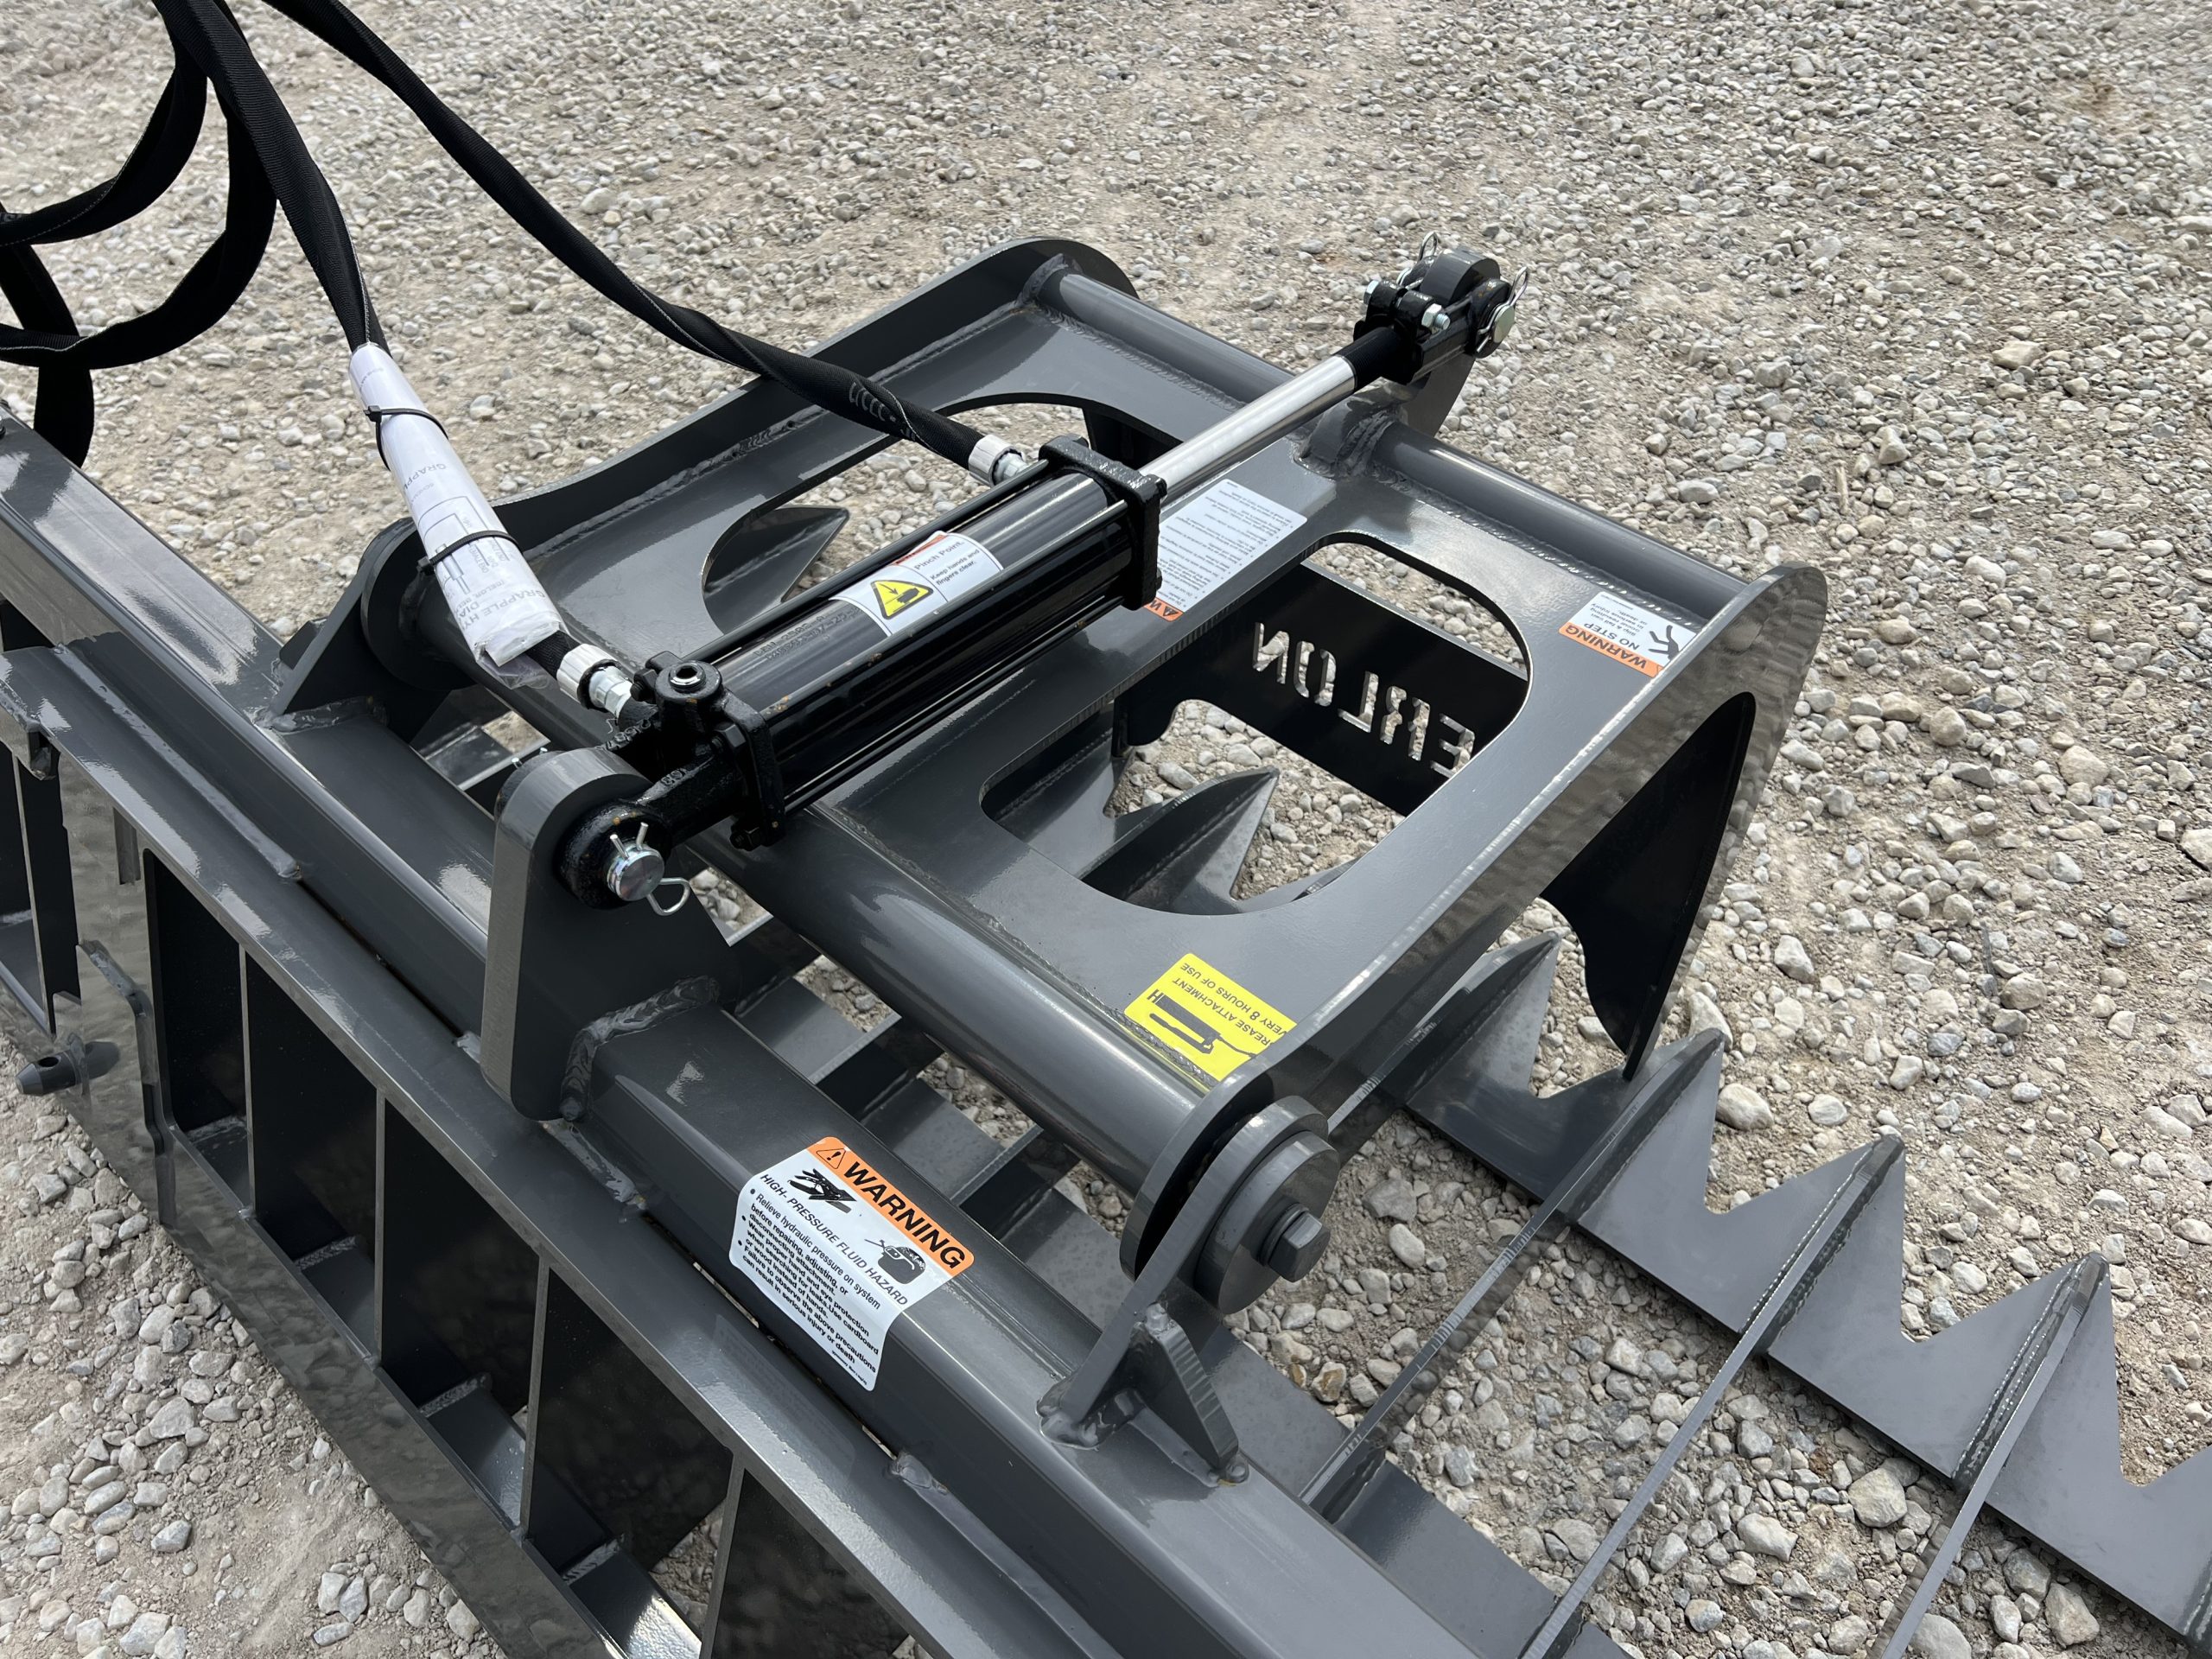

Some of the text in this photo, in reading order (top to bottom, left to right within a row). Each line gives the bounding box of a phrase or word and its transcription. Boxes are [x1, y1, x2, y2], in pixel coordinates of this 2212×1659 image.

[913, 553, 939, 570] Pinch
[938, 538, 964, 556] Point.
[930, 548, 980, 580] Keep hands and
[935, 559, 976, 586] fingers clear.
[481, 590, 545, 616] GRAPPLE
[1583, 620, 1639, 651] NO STEP
[1564, 623, 1647, 669] WARNING
[1172, 976, 1274, 1047] REASE ATTACHMENT
[1180, 963, 1287, 1037] VERY 8 HOURS OF USE
[748, 1212, 836, 1295] disconnecting attachment.
[749, 1203, 849, 1295] before repairing, adjusting, or
[755, 1193, 881, 1309] Relieve hydraulic pressure on system
[759, 1173, 908, 1306] HIGH- PRESSURE FLUID HAZARD
[843, 1161, 966, 1268] WARNING
[741, 1254, 856, 1363] can result in serious injury or death
[742, 1245, 767, 1268] Failure
[766, 1267, 774, 1276] to
[773, 1274, 802, 1301] observe
[800, 1300, 814, 1313] the
[812, 1312, 836, 1334] above
[834, 1332, 877, 1372] precautions
[745, 1238, 830, 1318] or wood instead of hands.
[747, 1220, 870, 1336] Wear proper hand and eye protection
[747, 1230, 765, 1249] when
[764, 1247, 798, 1280] searching
[797, 1276, 808, 1288] for
[842, 1319, 880, 1355] cardboard
